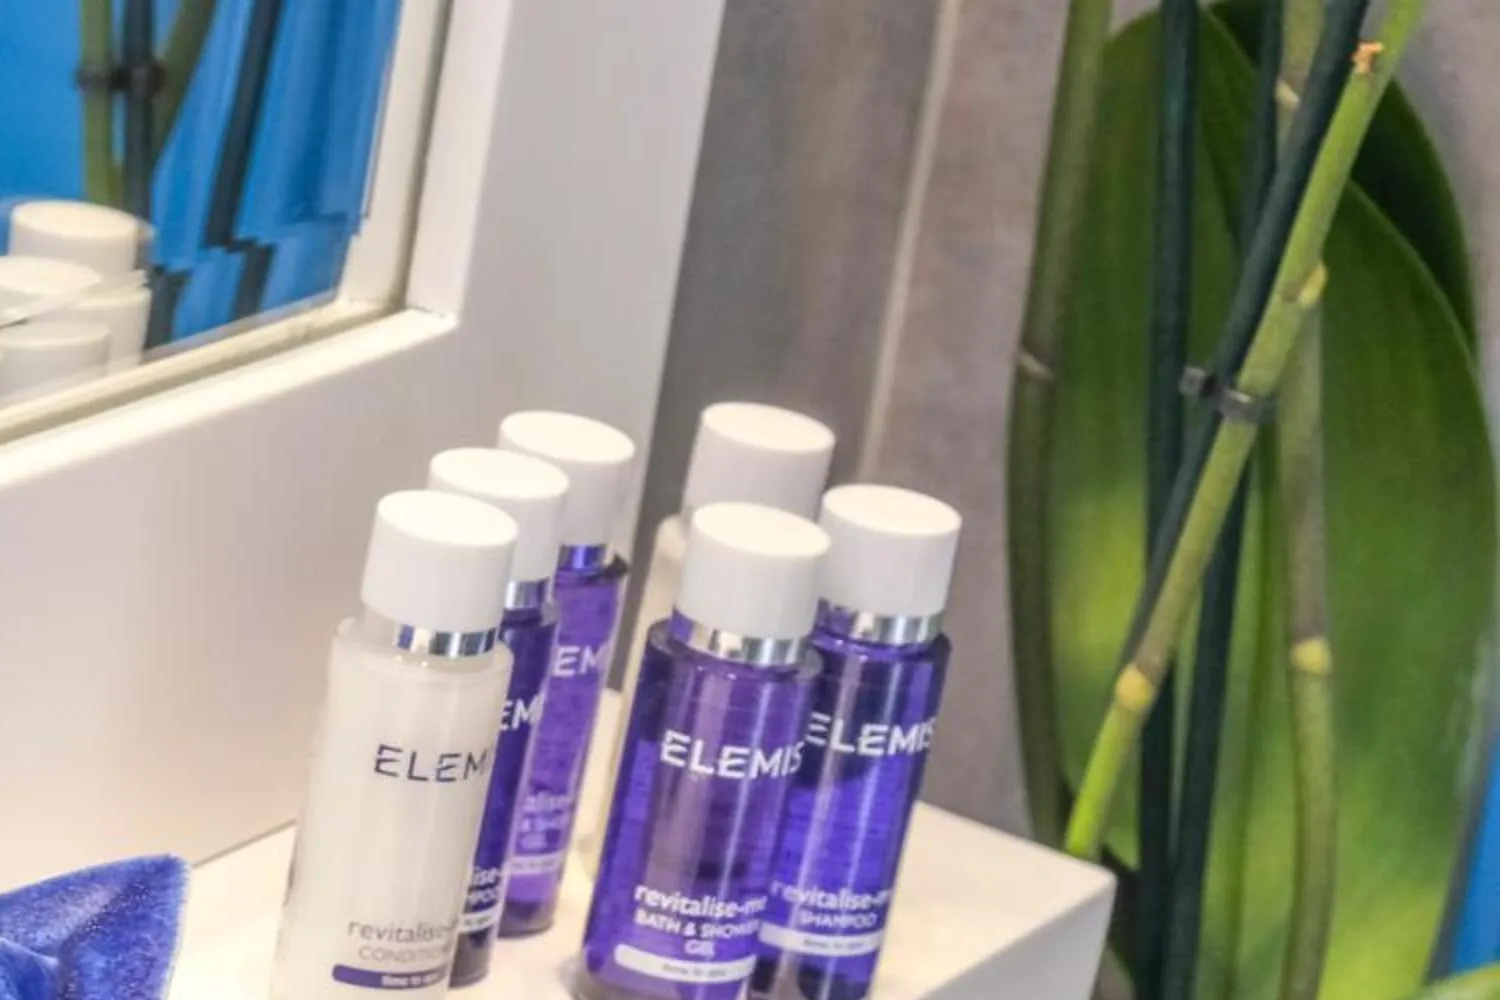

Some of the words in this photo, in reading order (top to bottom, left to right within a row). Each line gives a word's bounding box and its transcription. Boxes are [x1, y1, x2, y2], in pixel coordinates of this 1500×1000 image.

[659, 729, 805, 780] ELEMIS
[634, 907, 682, 934] BATH
[683, 921, 698, 937] &
